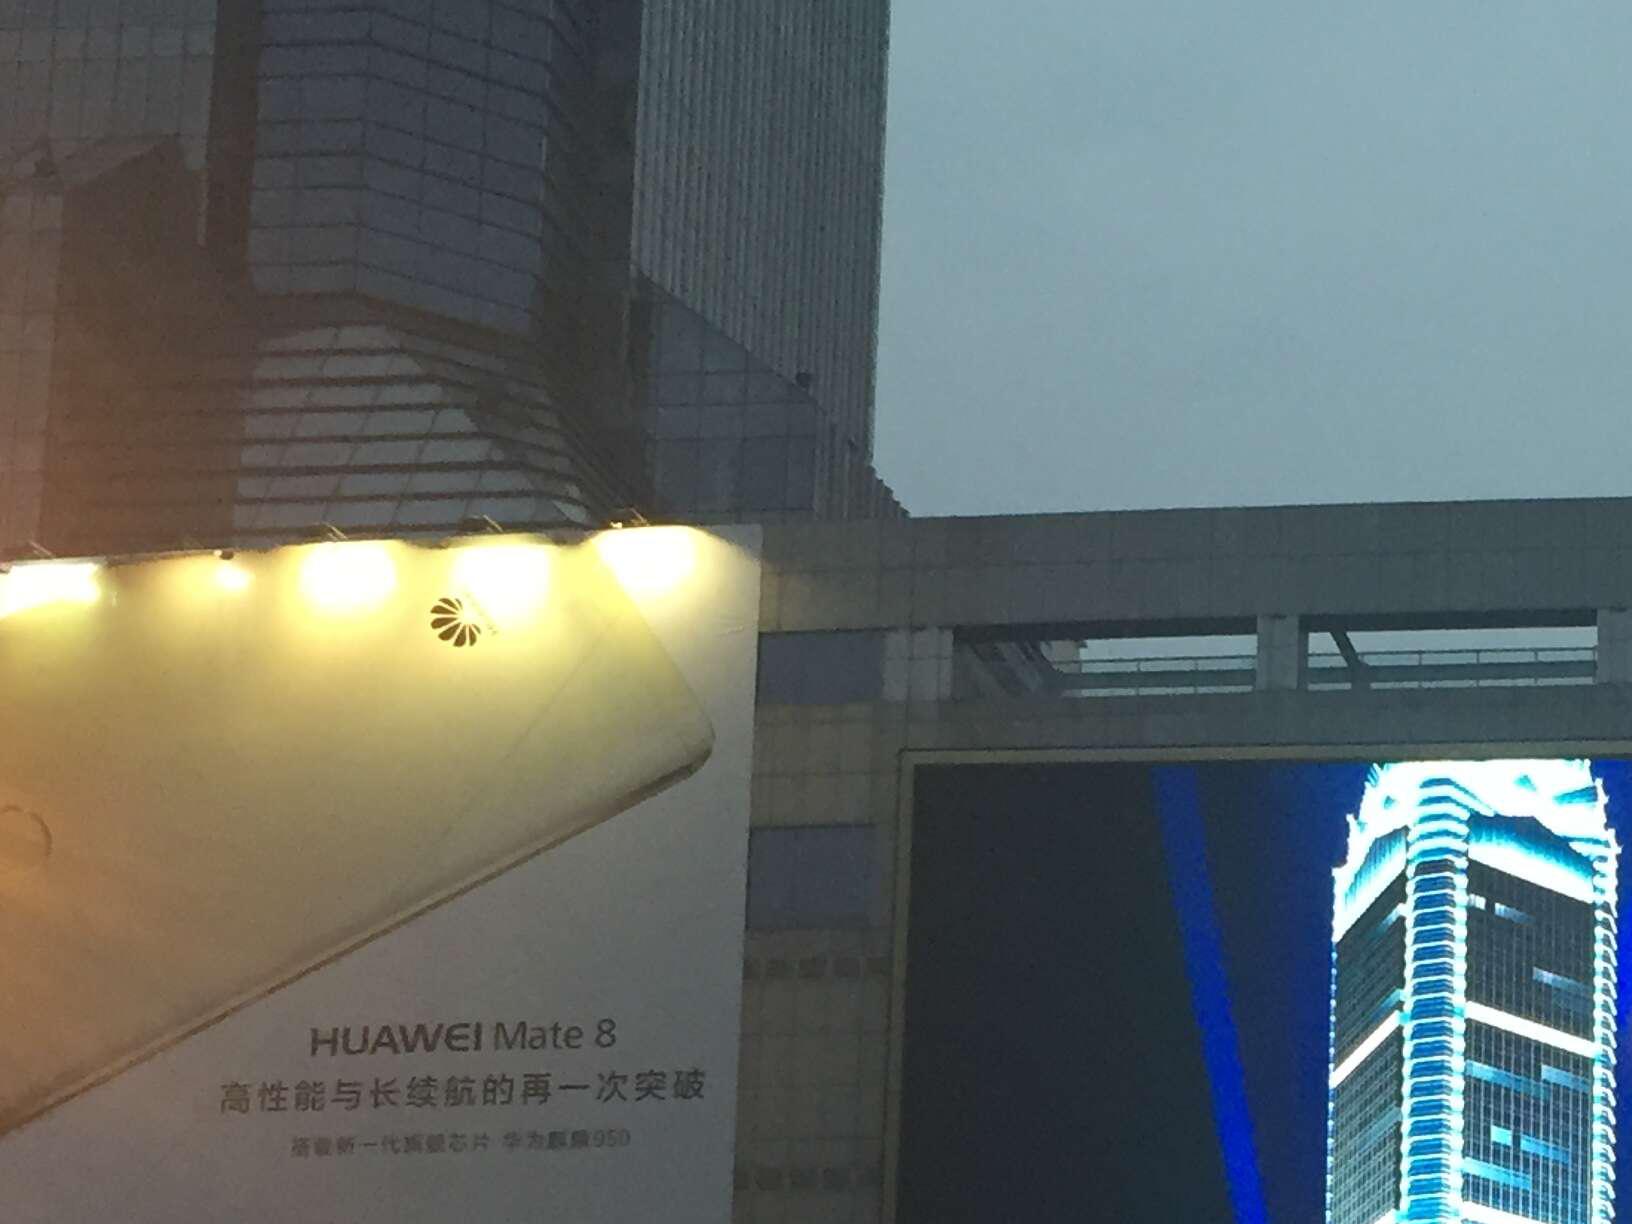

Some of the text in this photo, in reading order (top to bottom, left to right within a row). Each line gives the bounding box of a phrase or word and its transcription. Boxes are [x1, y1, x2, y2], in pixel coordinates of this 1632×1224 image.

[310, 1019, 617, 1057] HUAWEI Mate 8
[220, 1069, 707, 1116] 高性能与长续航的再一次突破
